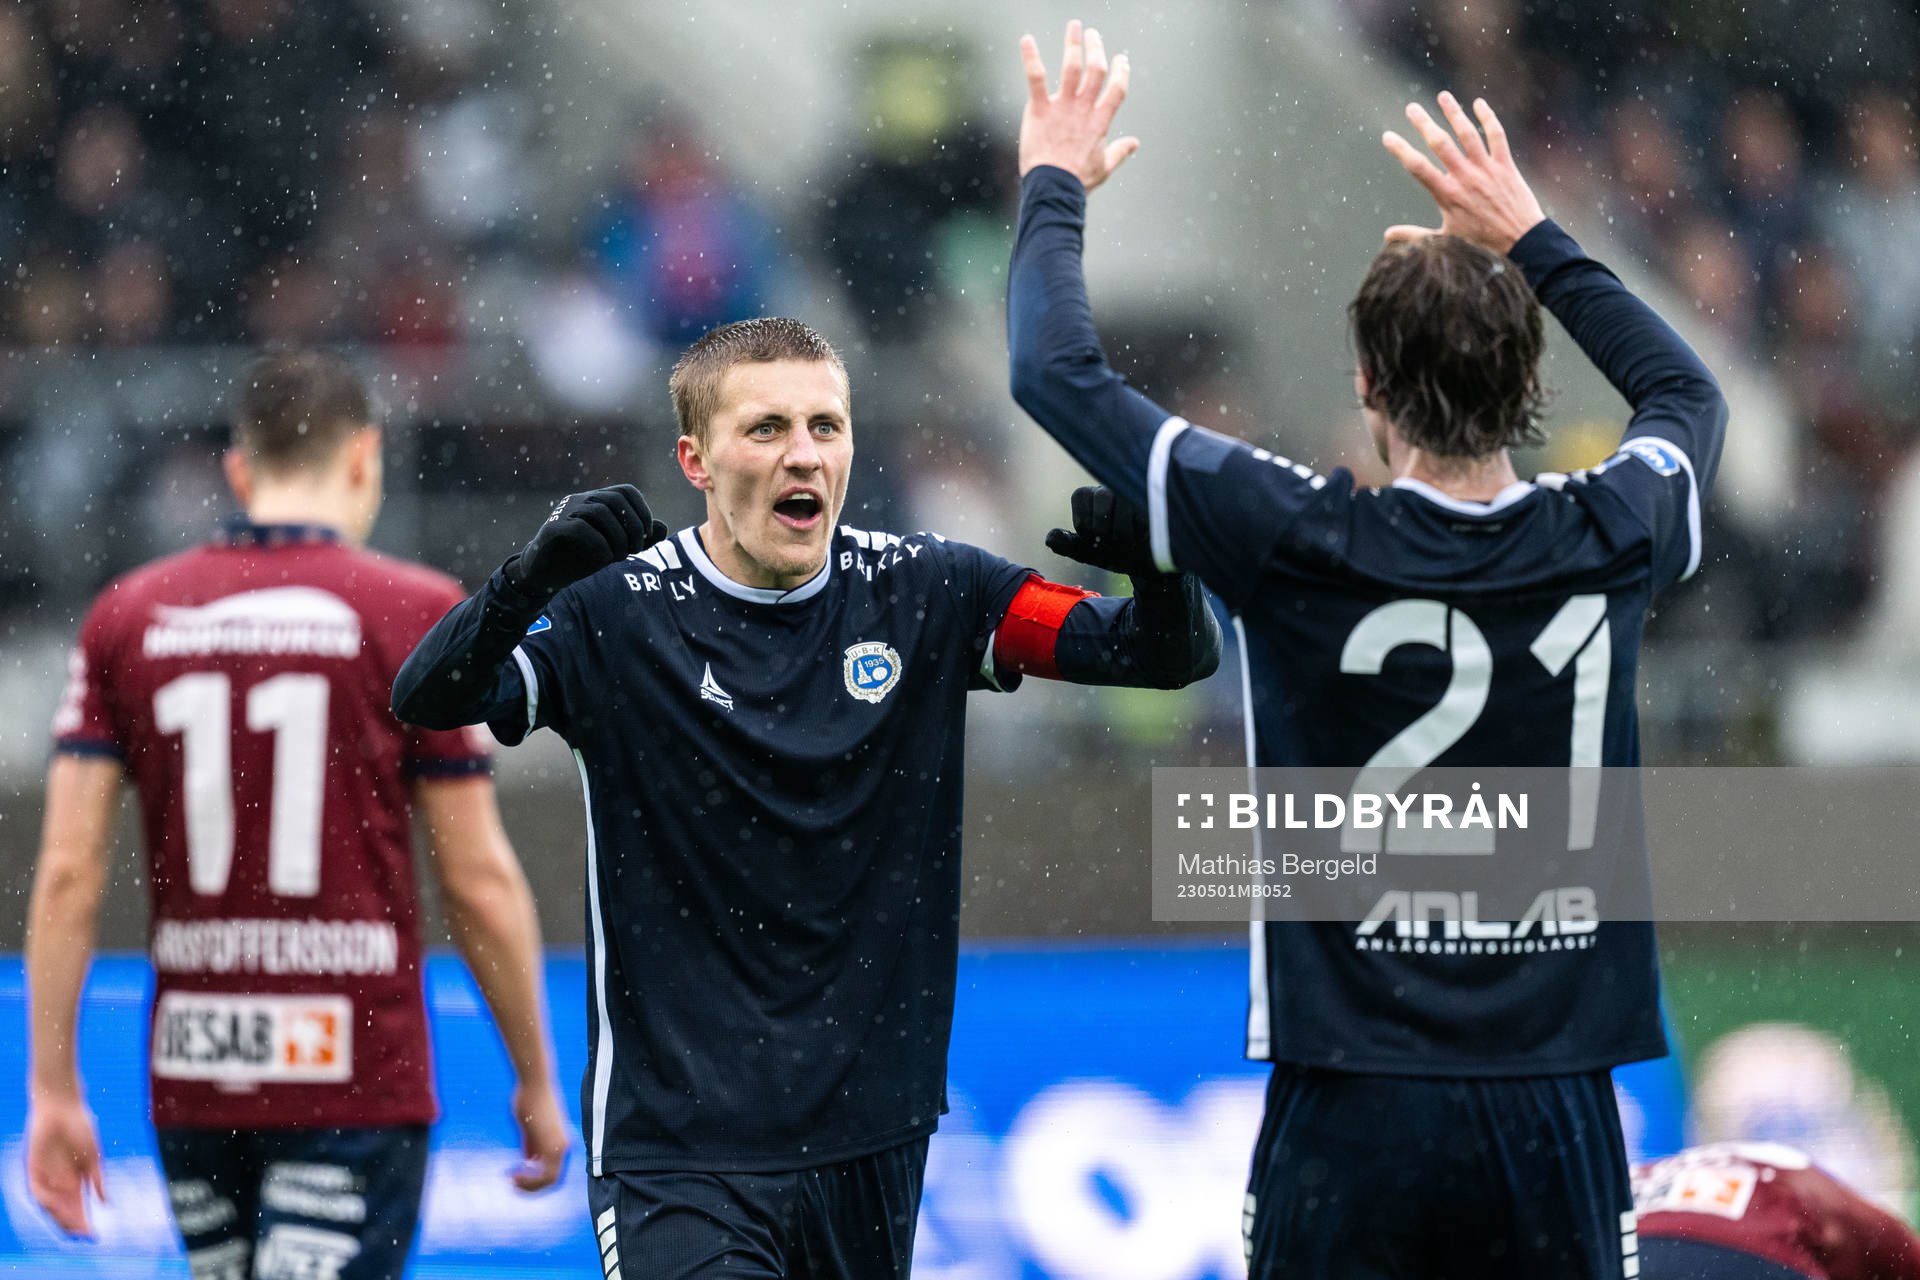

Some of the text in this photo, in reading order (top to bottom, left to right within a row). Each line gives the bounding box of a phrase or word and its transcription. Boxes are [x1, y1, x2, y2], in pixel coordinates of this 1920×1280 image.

[624, 572, 696, 601] BRILY
[153, 671, 331, 897] 11
[1340, 593, 1612, 856] 21
[1355, 886, 1600, 940] ANLAB
